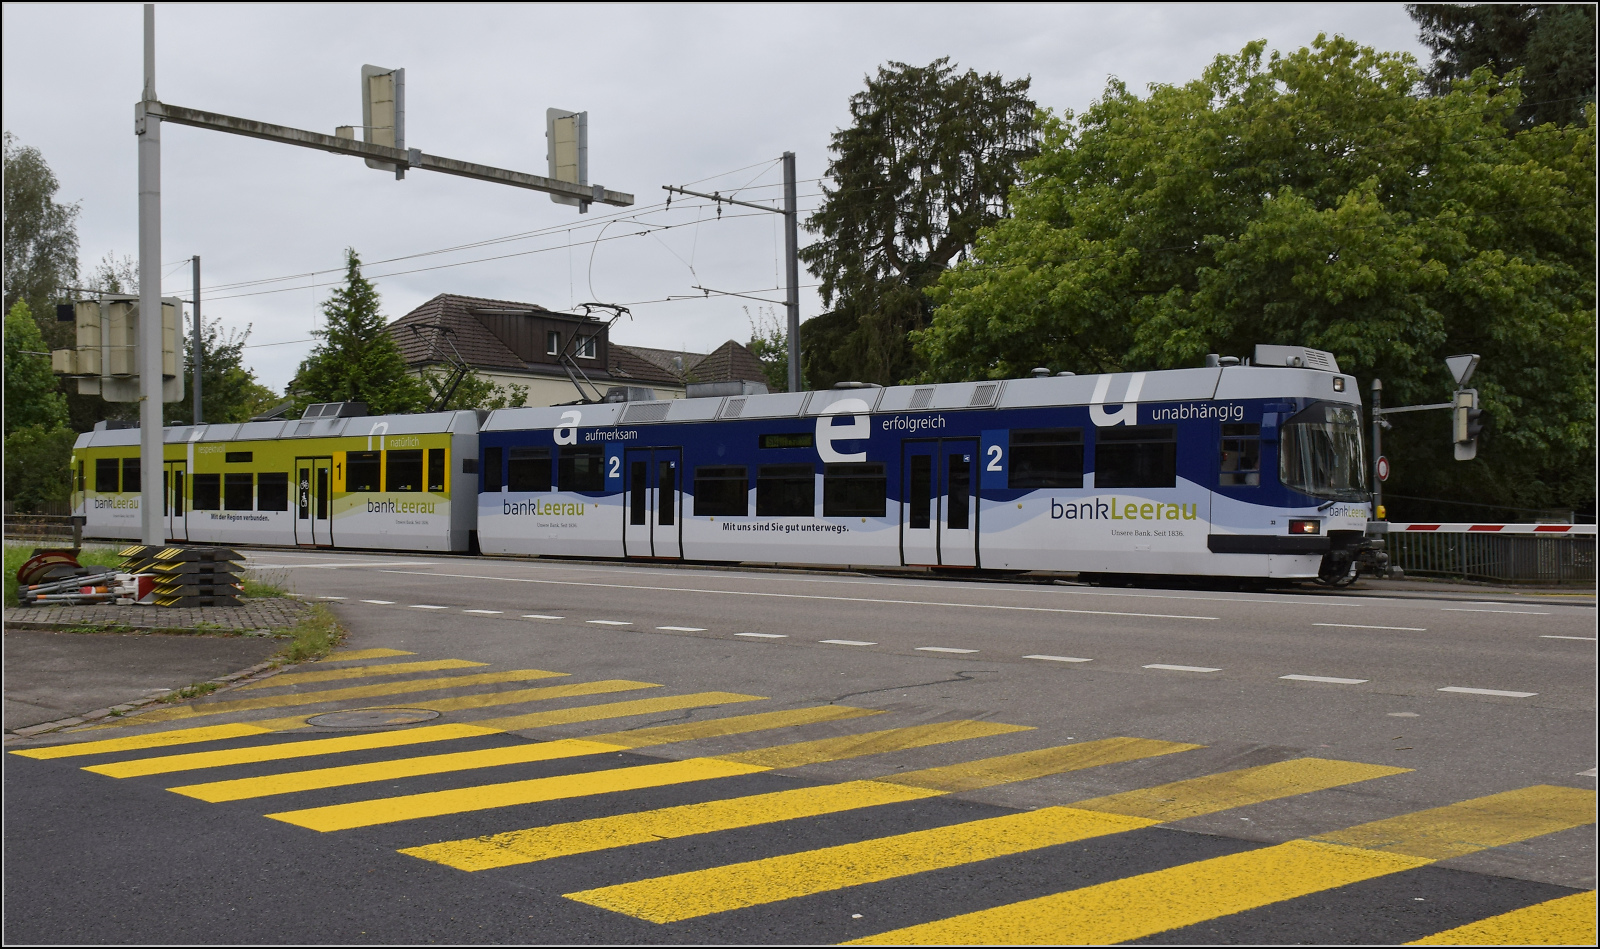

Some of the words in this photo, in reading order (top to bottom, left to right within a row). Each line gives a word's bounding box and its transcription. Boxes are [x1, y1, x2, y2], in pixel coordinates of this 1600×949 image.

[1152, 402, 1244, 422] unabhängig
[553, 410, 582, 446] a
[815, 398, 871, 463] e
[882, 413, 946, 433] erfolgreich
[367, 421, 389, 451] n
[390, 436, 420, 448] natürlich
[585, 429, 638, 441] aufmerksam
[608, 456, 620, 478] 2
[987, 445, 1003, 472] 2
[336, 463, 341, 480] 1
[94, 497, 139, 509] bankLeerau
[367, 498, 435, 514] bankLeerau
[503, 499, 585, 516] bankLeerau
[1051, 498, 1197, 520] bankLeerau
[226, 513, 243, 522] Region
[243, 514, 270, 522] verbunden.
[722, 522, 736, 531] Mit
[736, 523, 751, 532] uns
[752, 522, 770, 532] sind
[771, 522, 784, 532] Sie
[785, 523, 800, 533] gut
[801, 523, 850, 534] unterwegs.
[1134, 529, 1153, 537] Bank.
